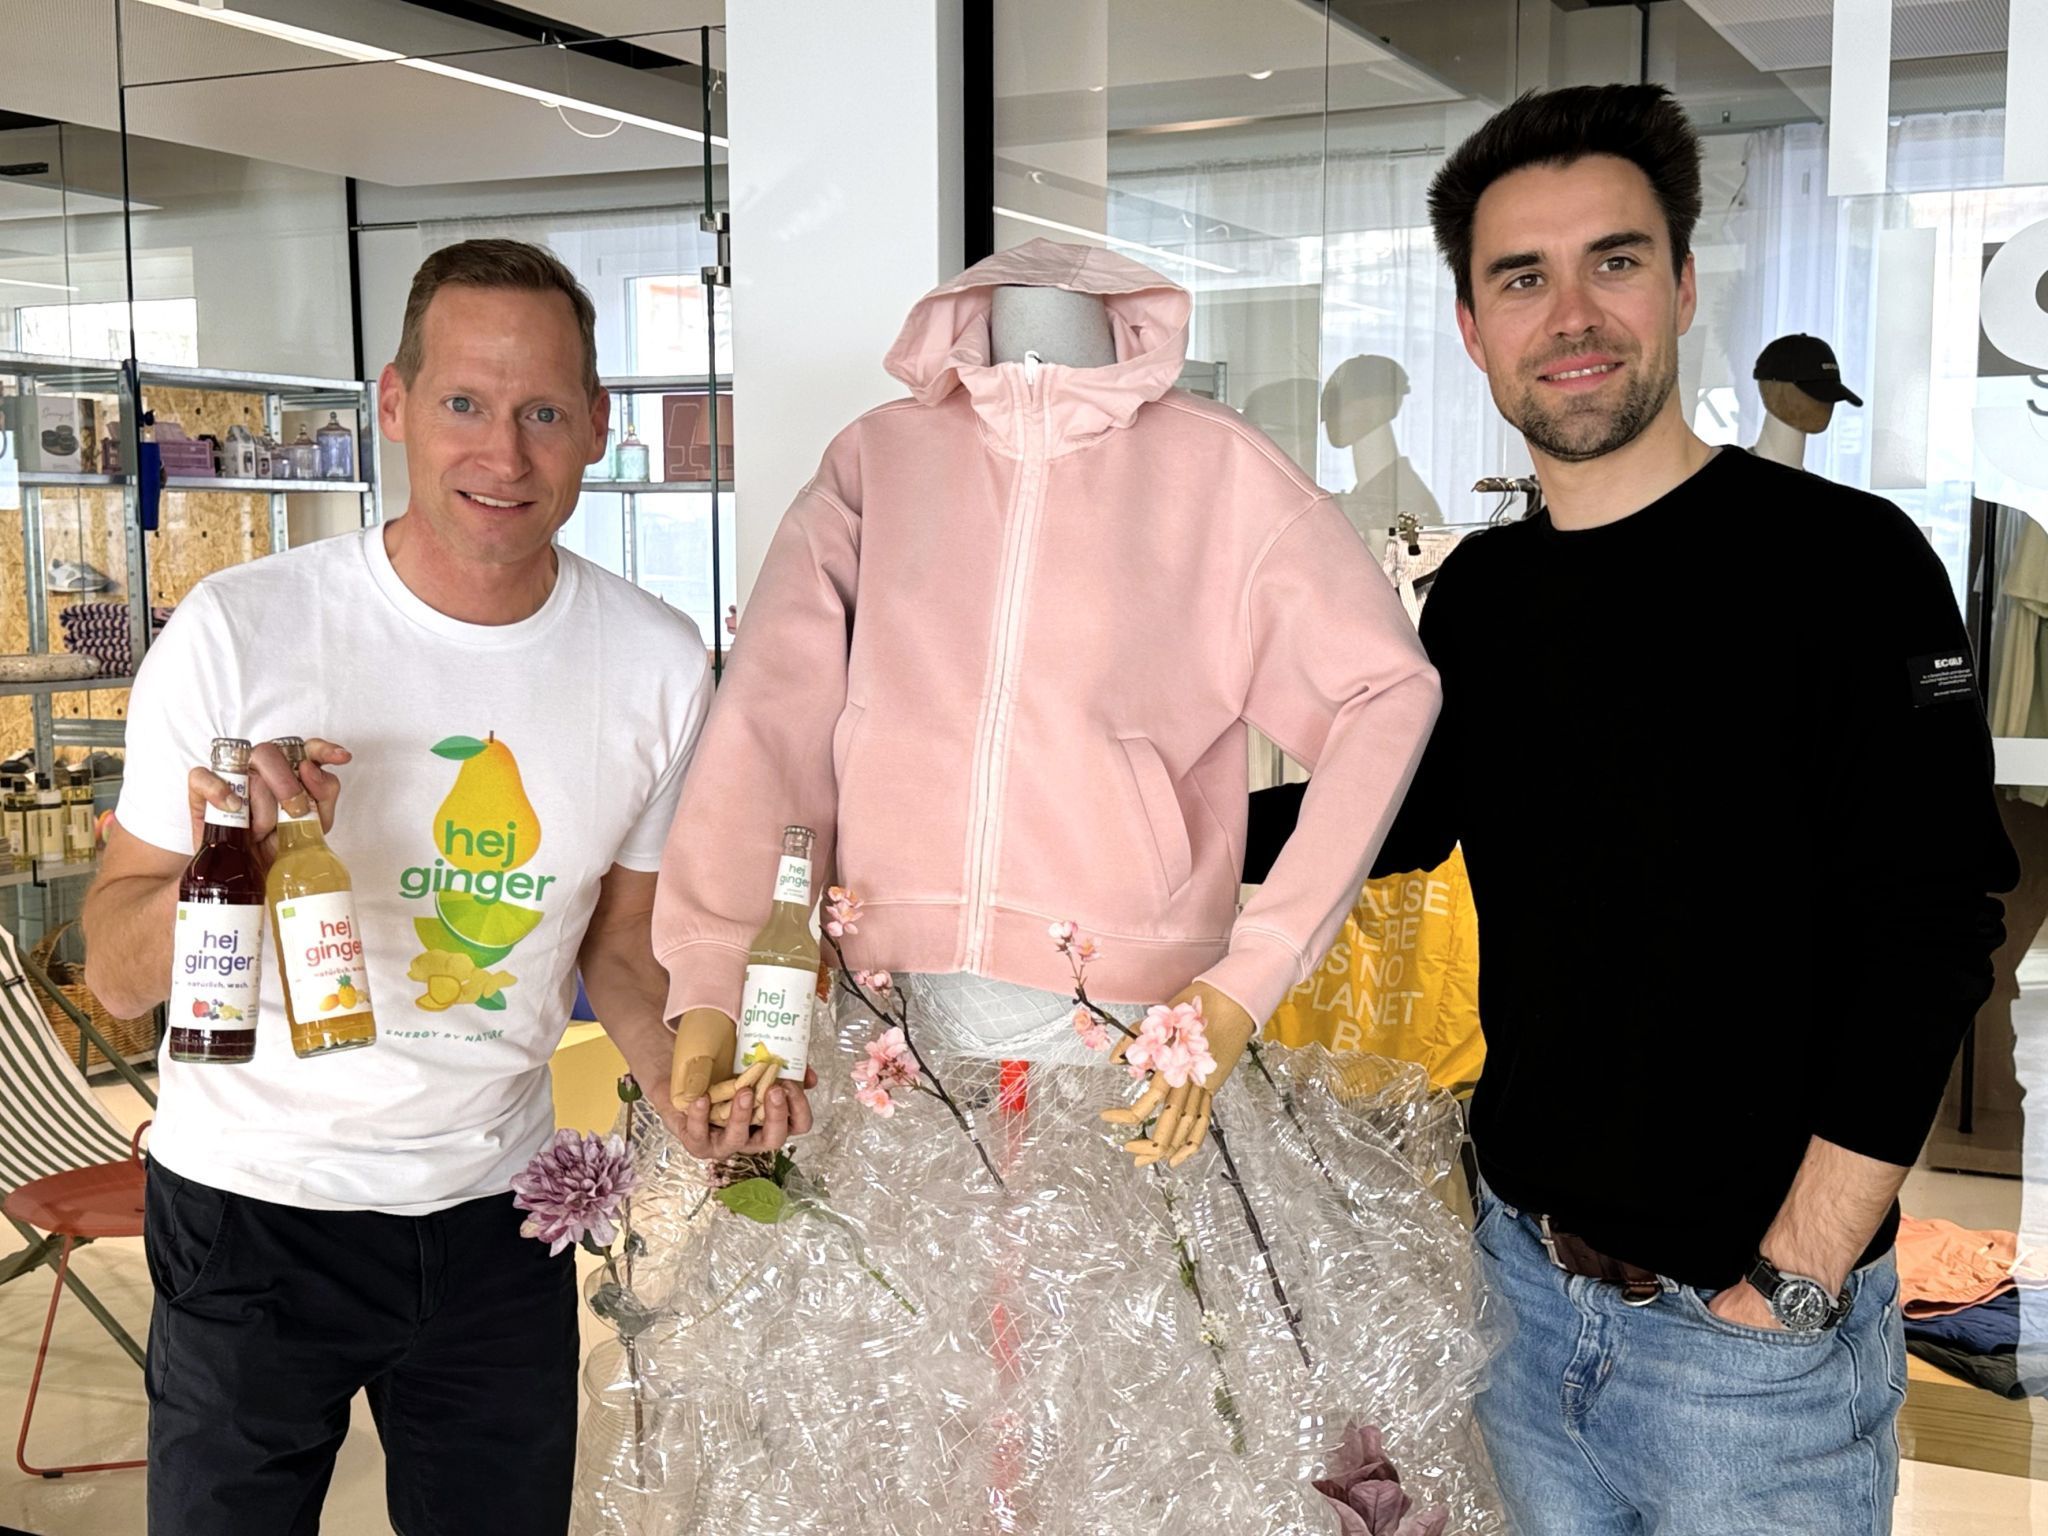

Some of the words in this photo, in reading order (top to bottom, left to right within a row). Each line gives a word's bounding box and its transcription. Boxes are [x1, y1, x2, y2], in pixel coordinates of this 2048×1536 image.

[445, 820, 516, 868] hej
[399, 858, 557, 905] ginger
[789, 863, 805, 877] hej
[1358, 880, 1450, 916] AUSE
[320, 915, 352, 939] hej
[203, 930, 238, 954] hej
[306, 940, 362, 967] ginge
[185, 950, 255, 976] ginger
[1360, 953, 1404, 988] NO
[757, 988, 786, 1009] hej
[1287, 977, 1424, 1025] PLANET
[743, 1004, 800, 1028] ginger
[1331, 1018, 1362, 1053] B
